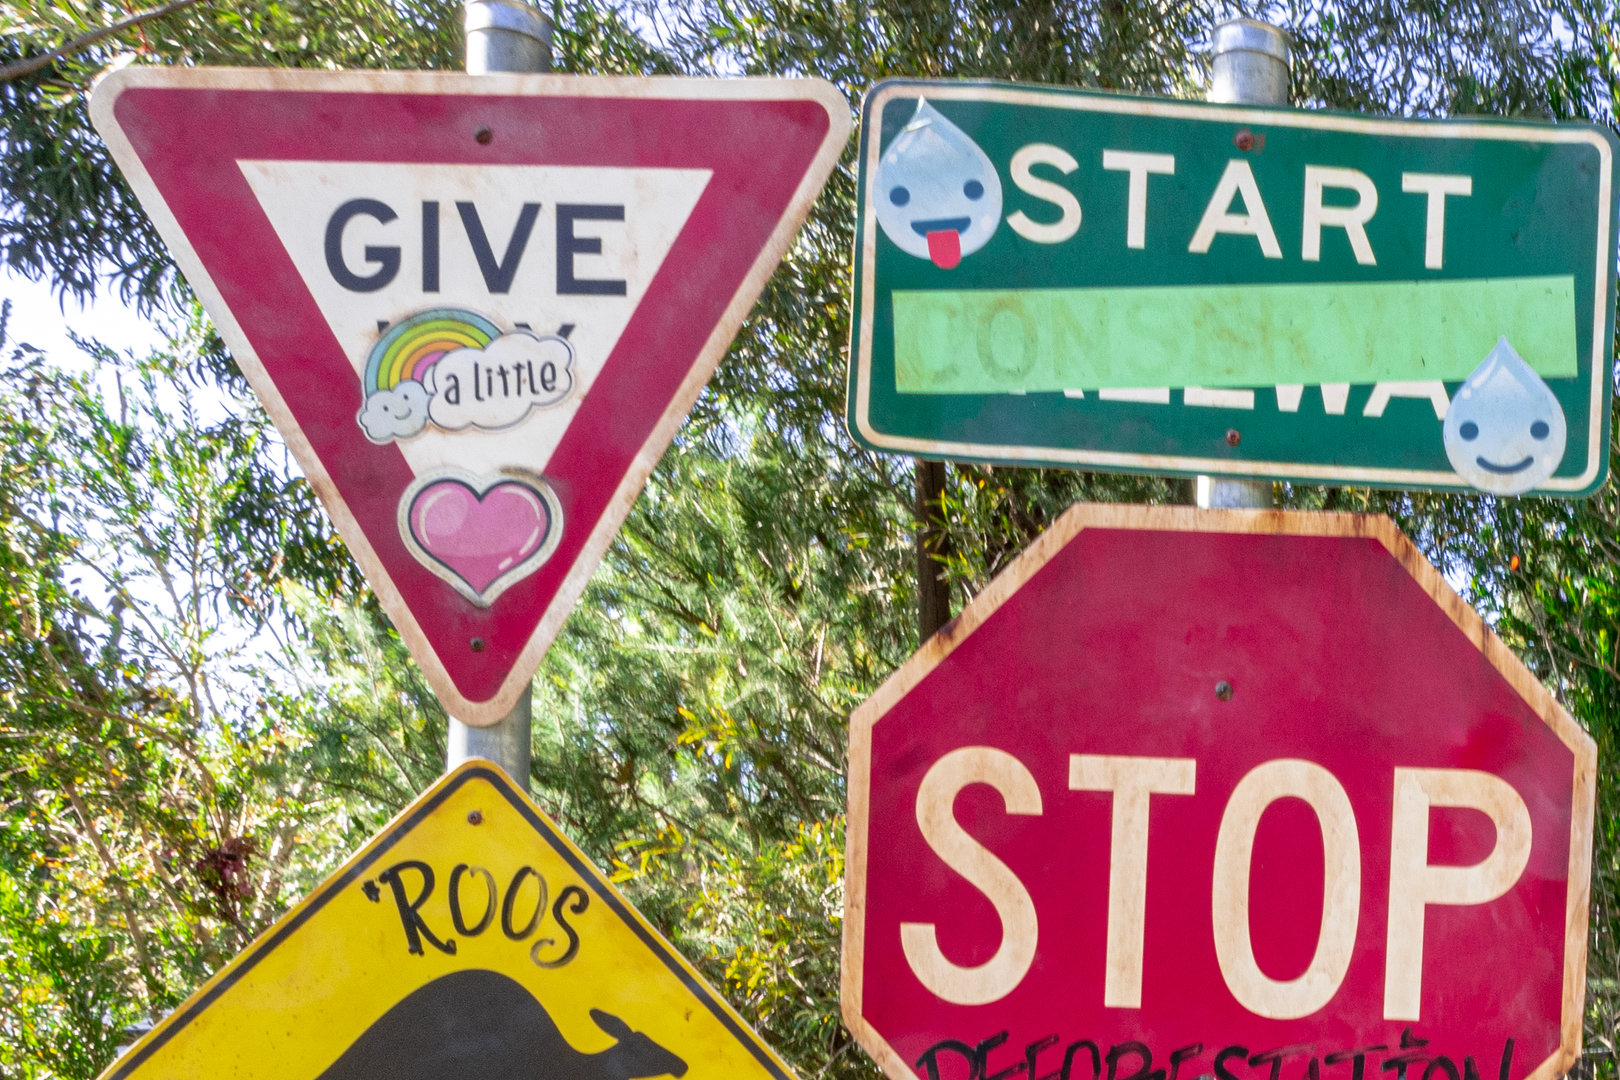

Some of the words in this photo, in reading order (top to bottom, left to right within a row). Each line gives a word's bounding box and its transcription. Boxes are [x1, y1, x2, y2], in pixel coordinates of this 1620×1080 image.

[324, 197, 628, 296] GIVE
[1006, 142, 1473, 270] START
[444, 373, 461, 405] a
[474, 359, 557, 402] little
[900, 745, 1533, 1021] STOP
